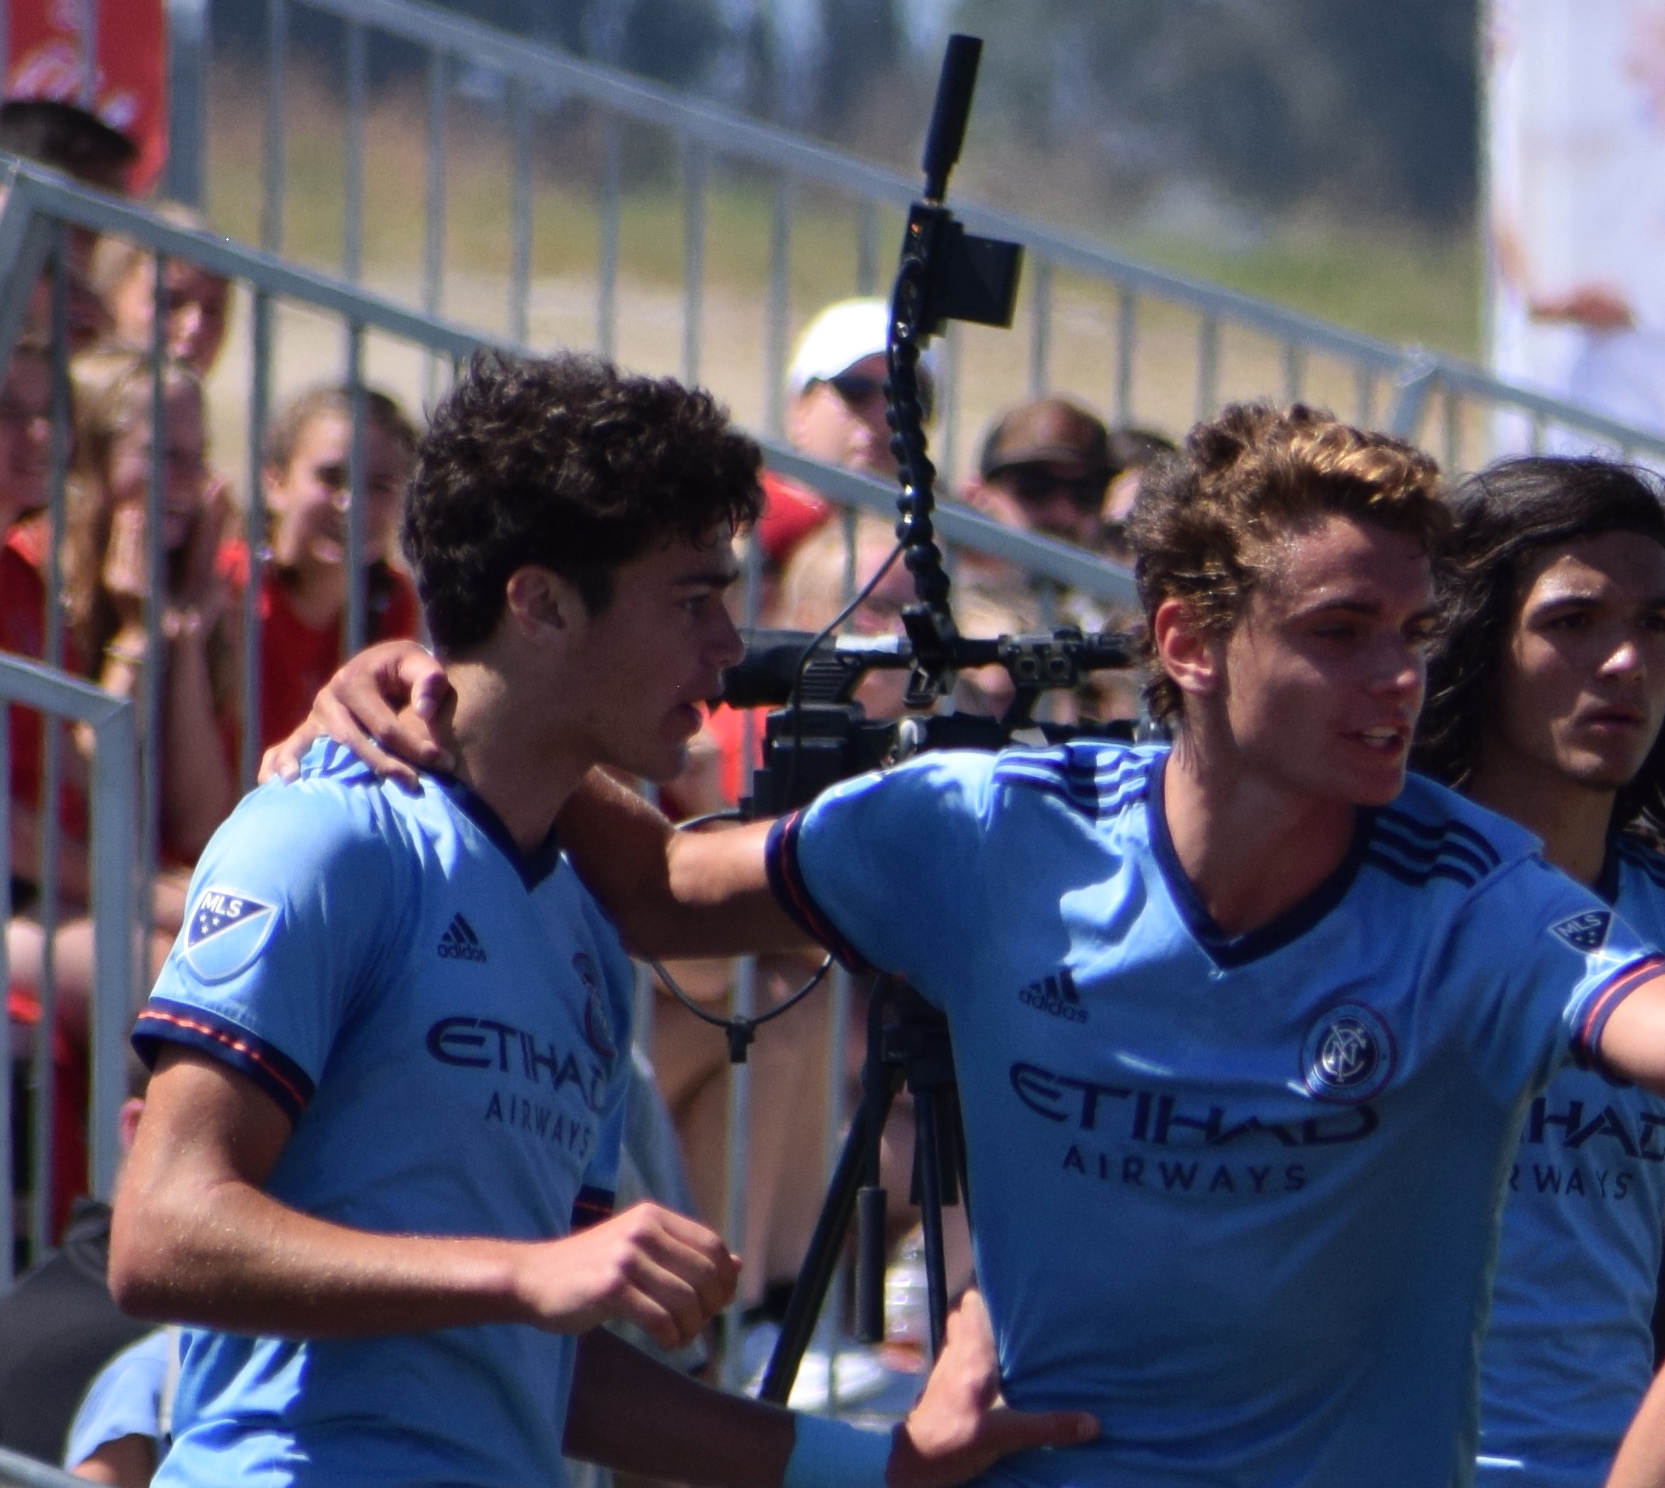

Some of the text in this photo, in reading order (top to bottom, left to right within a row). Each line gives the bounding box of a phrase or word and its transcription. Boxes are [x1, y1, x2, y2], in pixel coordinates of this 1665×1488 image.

[200, 892, 243, 918] MLS
[1557, 914, 1604, 940] MLS
[436, 942, 488, 964] adidas
[1018, 987, 1089, 1025] adidas
[1009, 1061, 1379, 1148] ETIHAD
[485, 1090, 592, 1159] AIRWAYS
[1061, 1143, 1306, 1193] AIRWAYS
[1508, 1161, 1634, 1200] RWAYS
